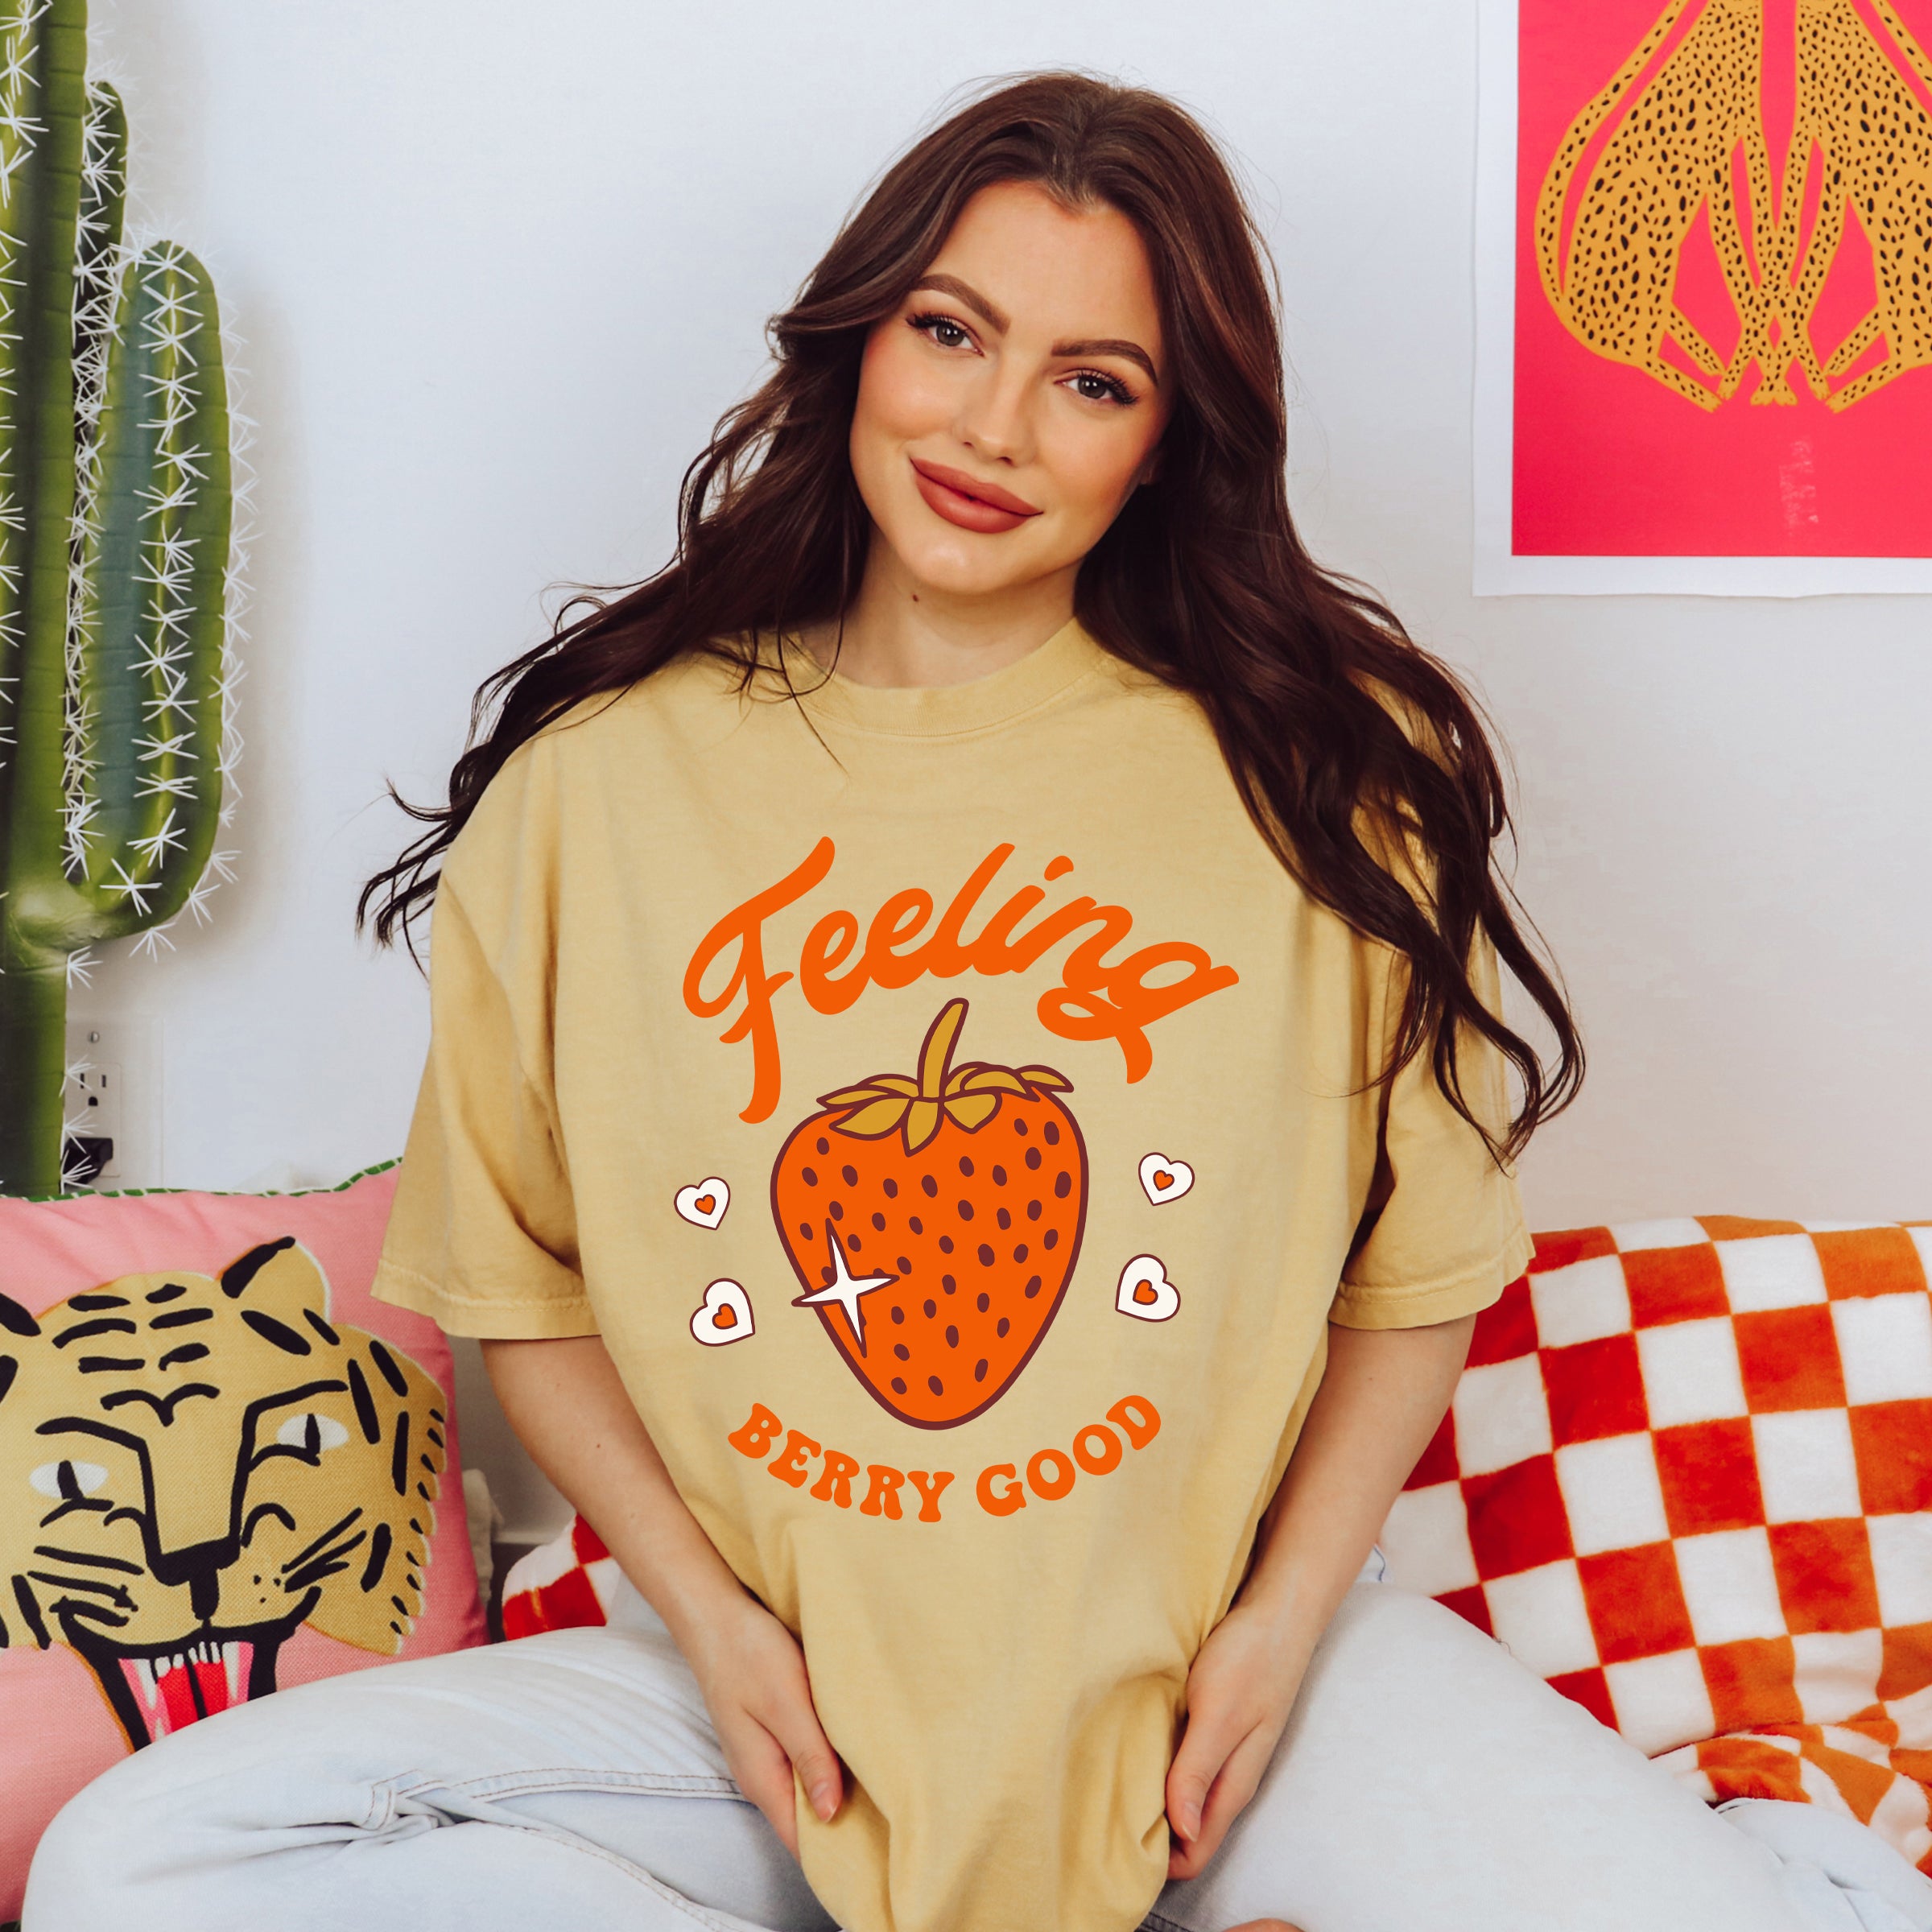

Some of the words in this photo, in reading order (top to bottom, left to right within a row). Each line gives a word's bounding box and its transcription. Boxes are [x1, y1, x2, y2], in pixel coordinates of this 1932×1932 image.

[683, 836, 1240, 1125] Feeling
[727, 1402, 956, 1523] BERRY
[976, 1395, 1162, 1517] GOOD
